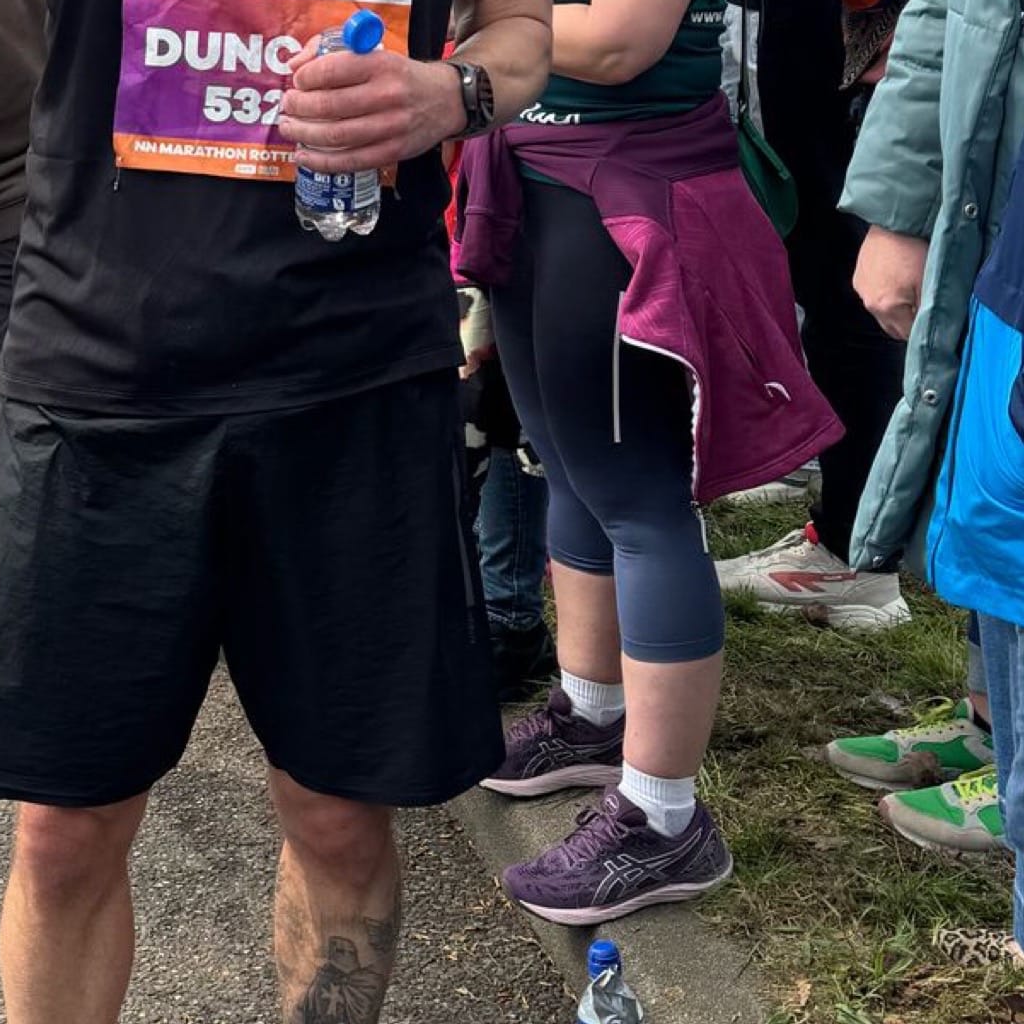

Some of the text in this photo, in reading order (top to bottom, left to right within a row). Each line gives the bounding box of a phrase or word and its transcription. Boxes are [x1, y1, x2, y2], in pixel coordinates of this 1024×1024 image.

[144, 26, 301, 75] DUNC
[202, 85, 284, 125] 532
[134, 140, 157, 153] NN
[159, 142, 247, 161] MARATHON
